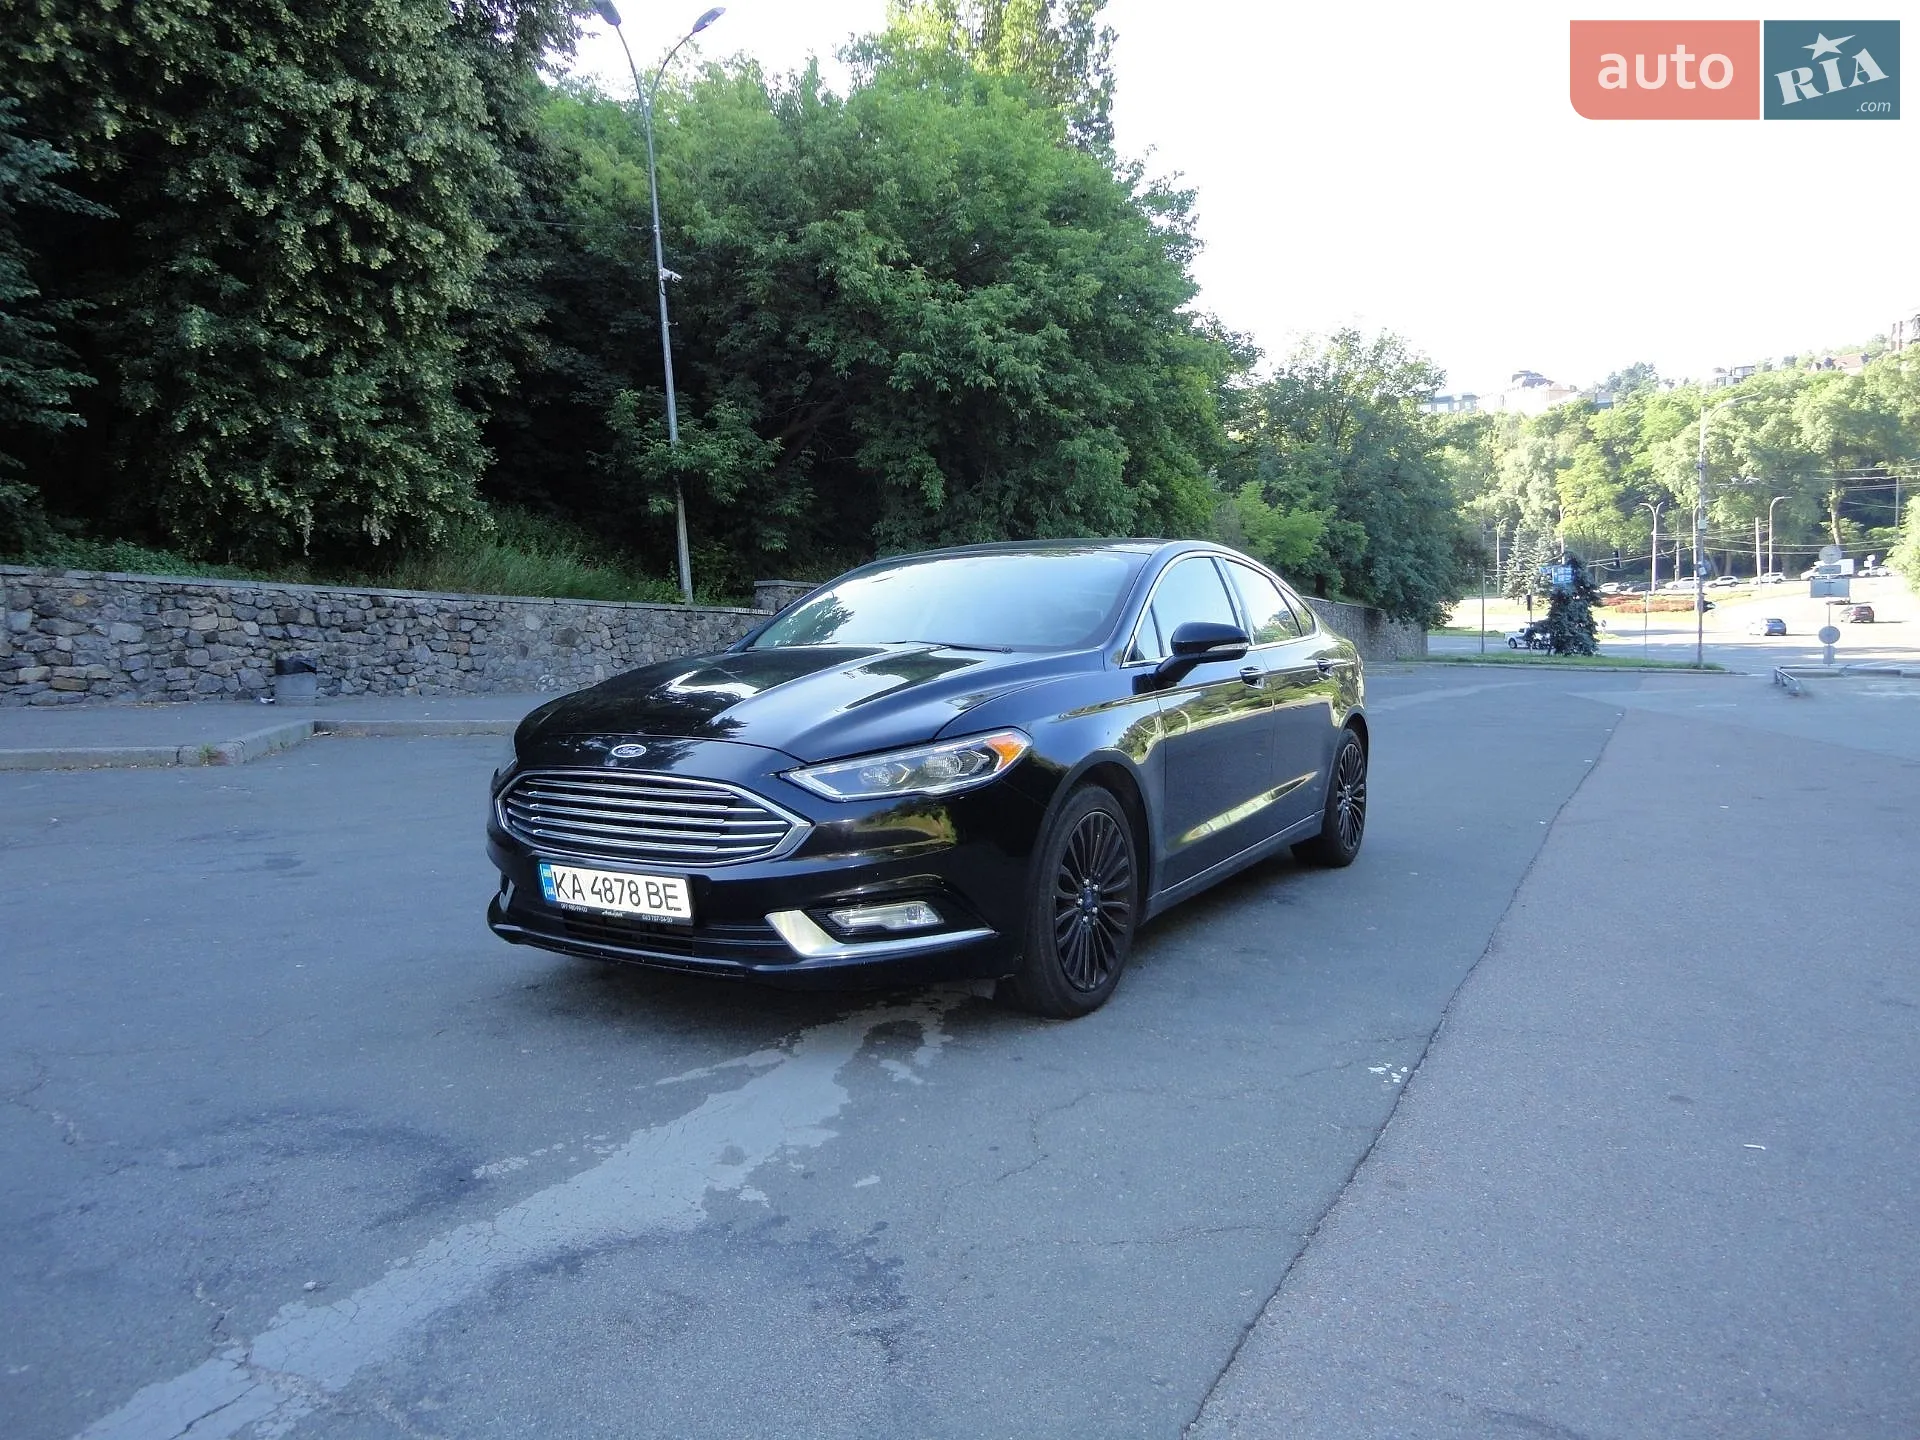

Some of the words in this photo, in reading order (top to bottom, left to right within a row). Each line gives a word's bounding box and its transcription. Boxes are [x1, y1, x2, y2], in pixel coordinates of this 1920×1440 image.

[553, 871, 586, 901] KA
[590, 876, 641, 907] 4878
[645, 881, 682, 912] BE
